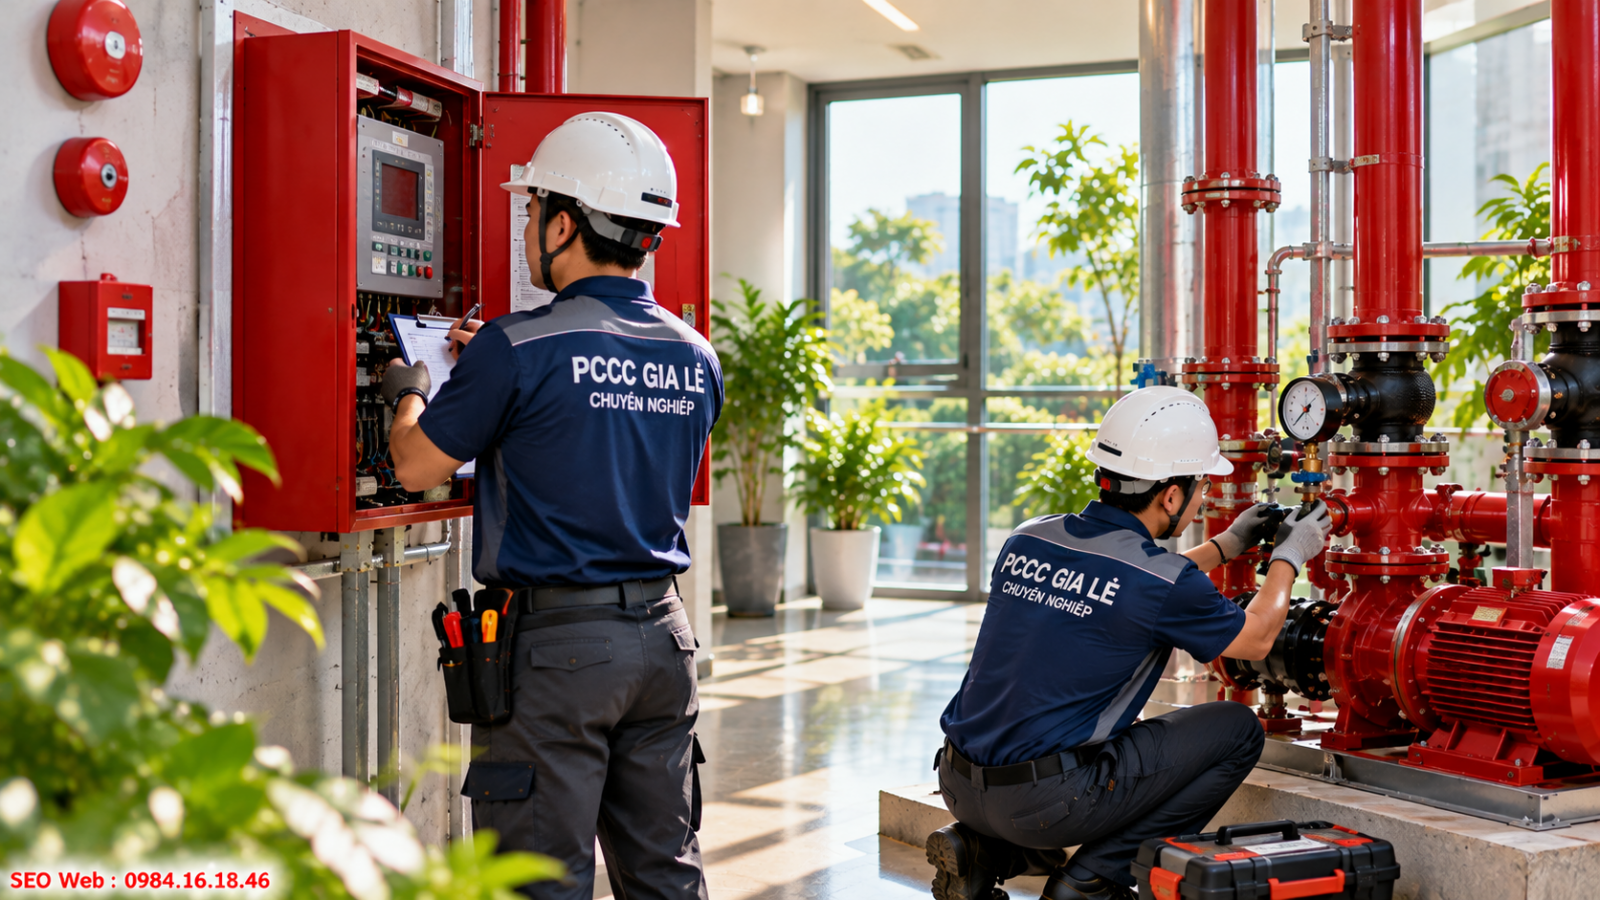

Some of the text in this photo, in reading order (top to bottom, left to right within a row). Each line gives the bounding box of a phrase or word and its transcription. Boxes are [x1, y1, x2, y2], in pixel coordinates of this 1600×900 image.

[571, 355, 637, 386] PCCC
[642, 362, 680, 390] GIA
[1000, 552, 1052, 583] PCCC
[1051, 567, 1085, 595] GIA
